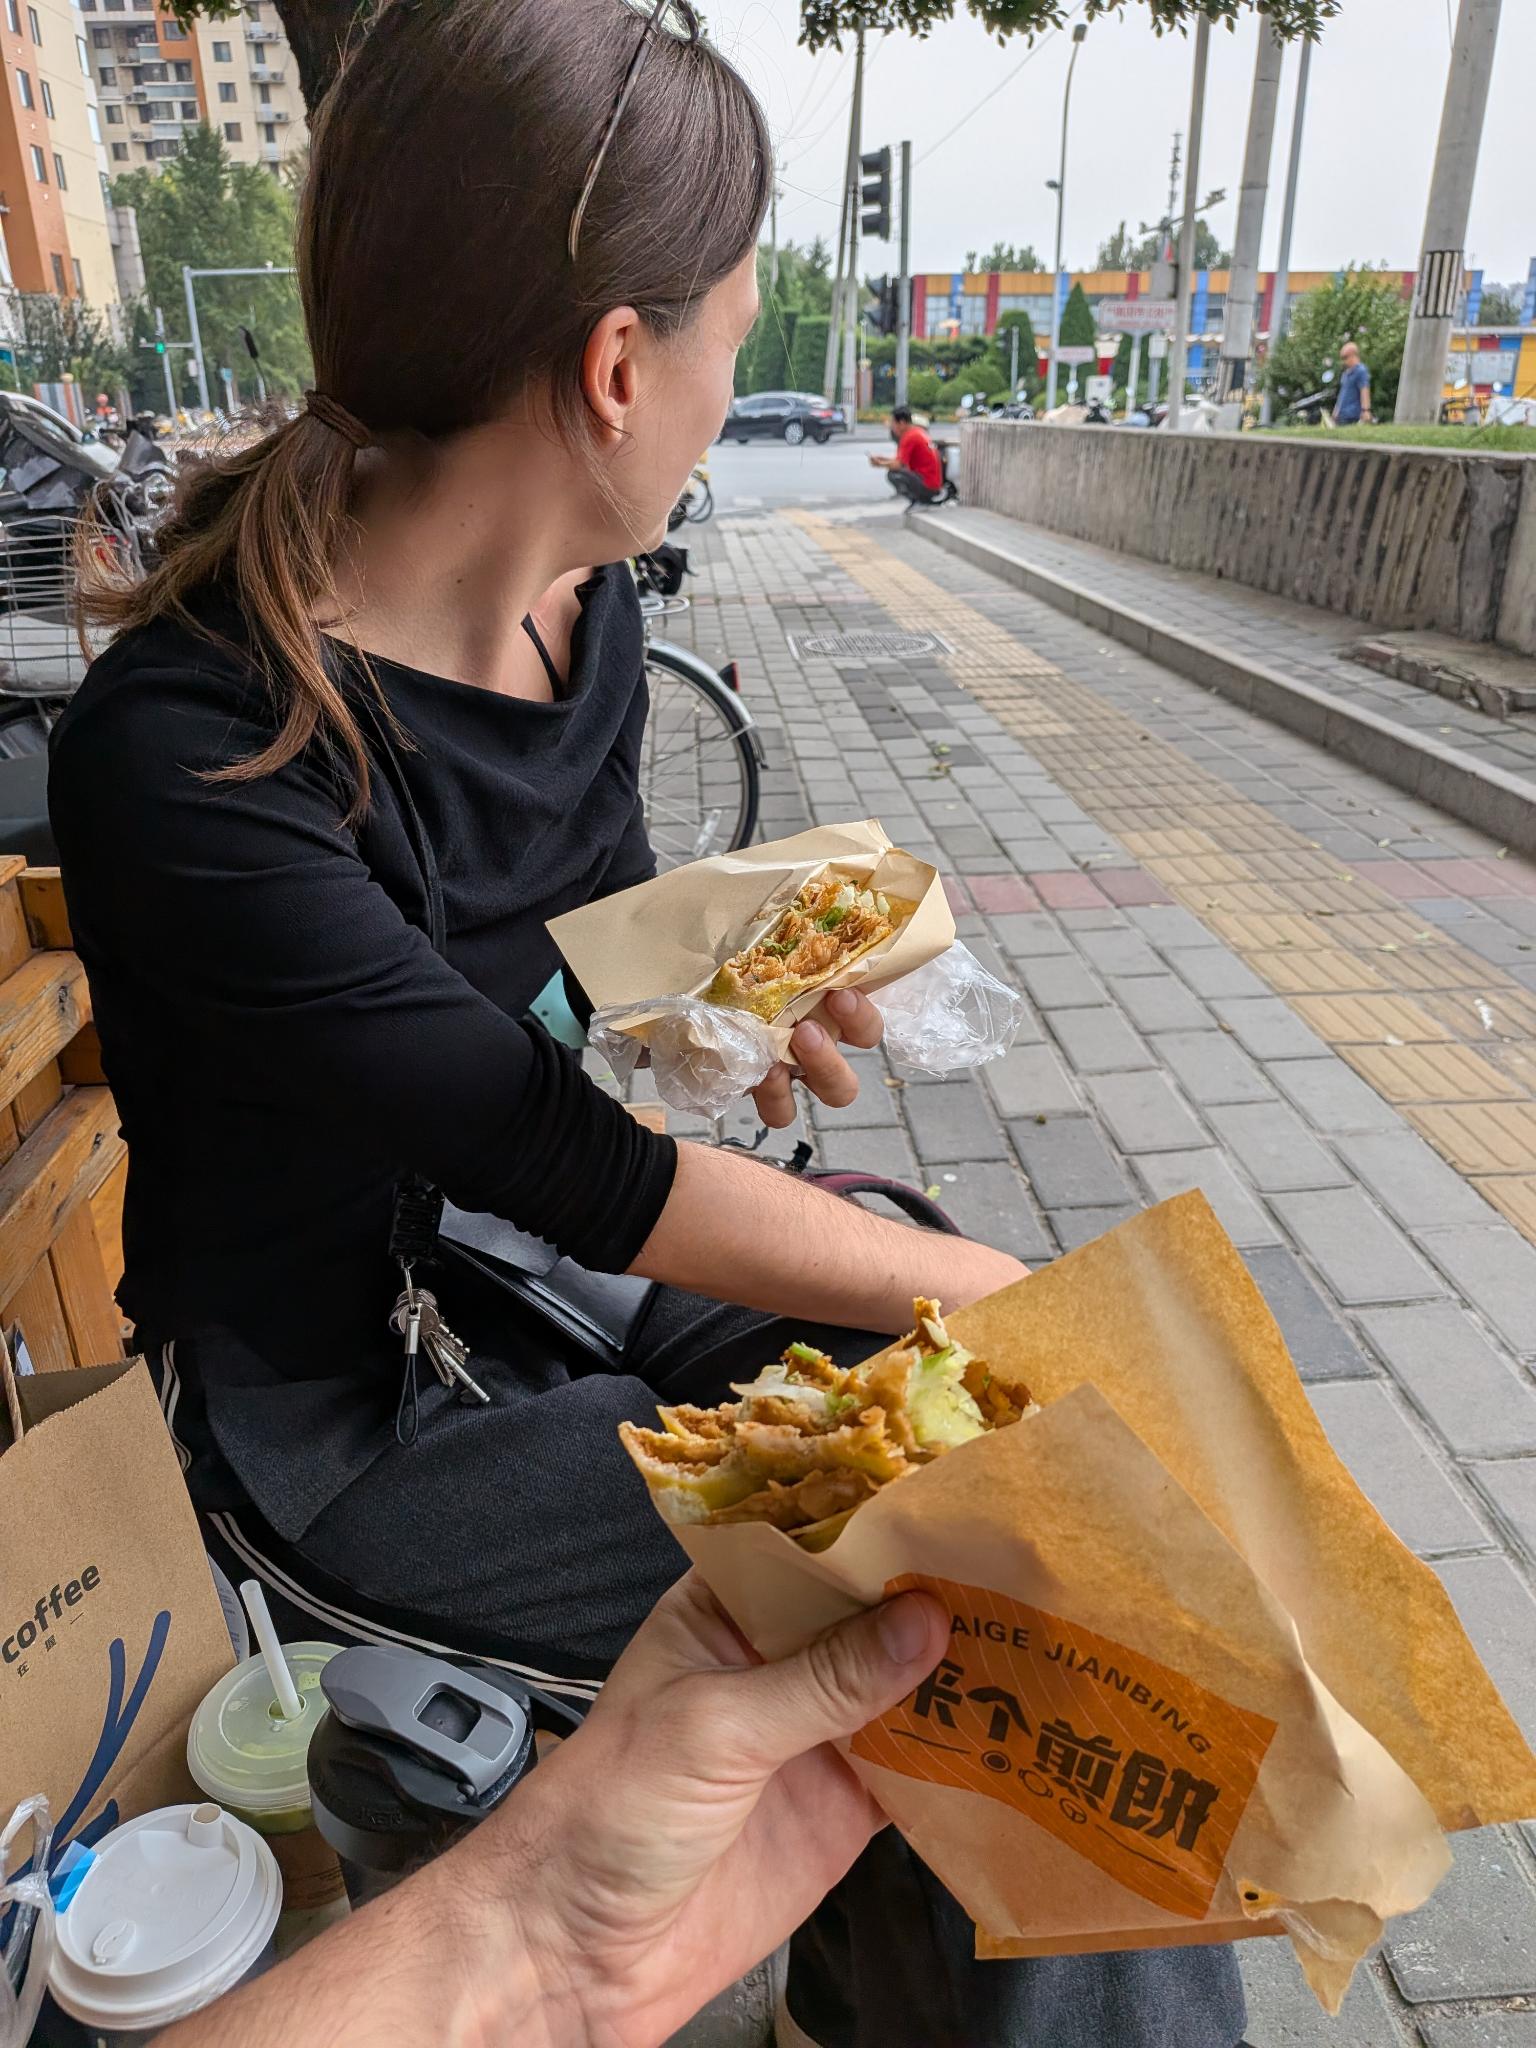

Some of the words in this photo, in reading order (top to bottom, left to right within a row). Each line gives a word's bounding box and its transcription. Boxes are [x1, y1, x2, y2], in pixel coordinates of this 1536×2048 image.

[1, 1565, 101, 1664] coffee
[950, 1615, 1031, 1651] AIGE
[1044, 1641, 1213, 1755] JIANBING
